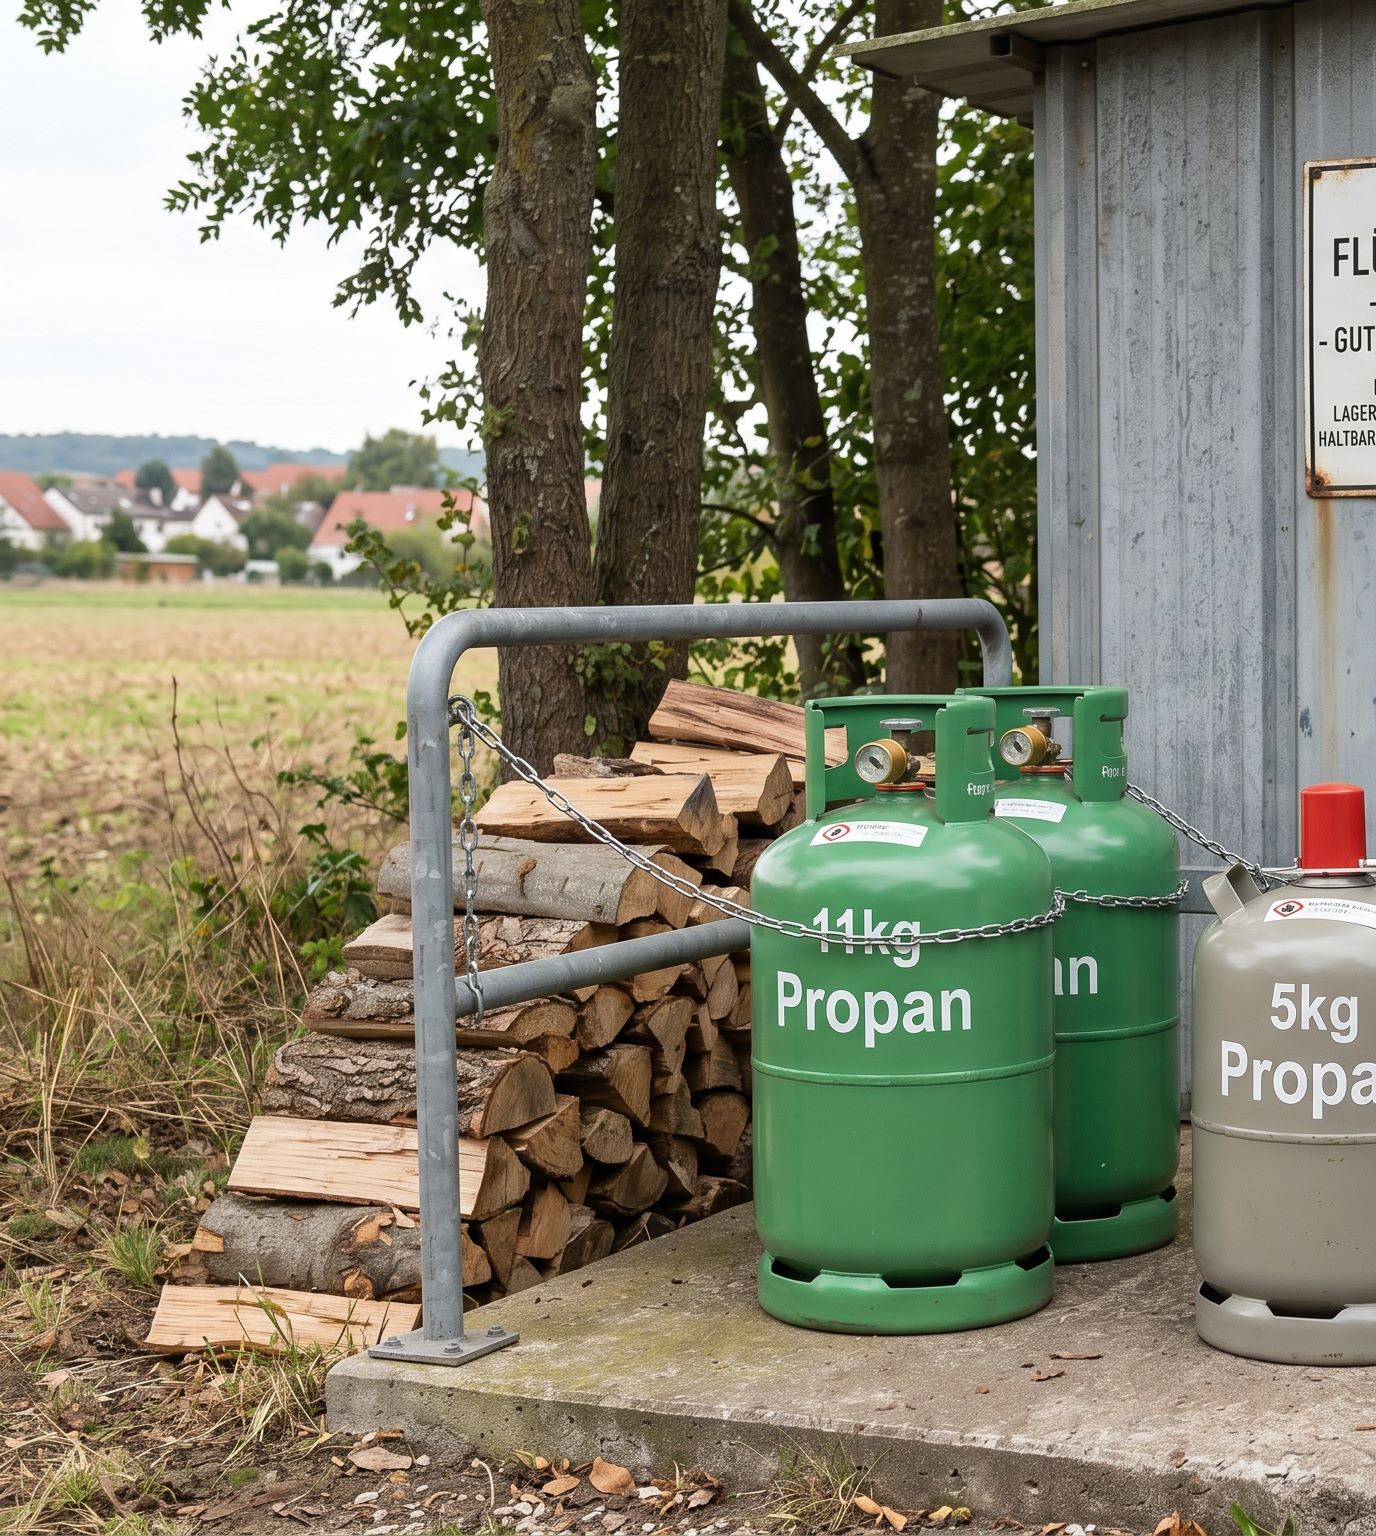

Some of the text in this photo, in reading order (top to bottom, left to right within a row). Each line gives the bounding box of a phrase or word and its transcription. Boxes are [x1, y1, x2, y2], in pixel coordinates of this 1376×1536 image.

[812, 907, 921, 968] 11kg
[777, 970, 972, 1049] Propan
[1270, 982, 1358, 1044] 5kg
